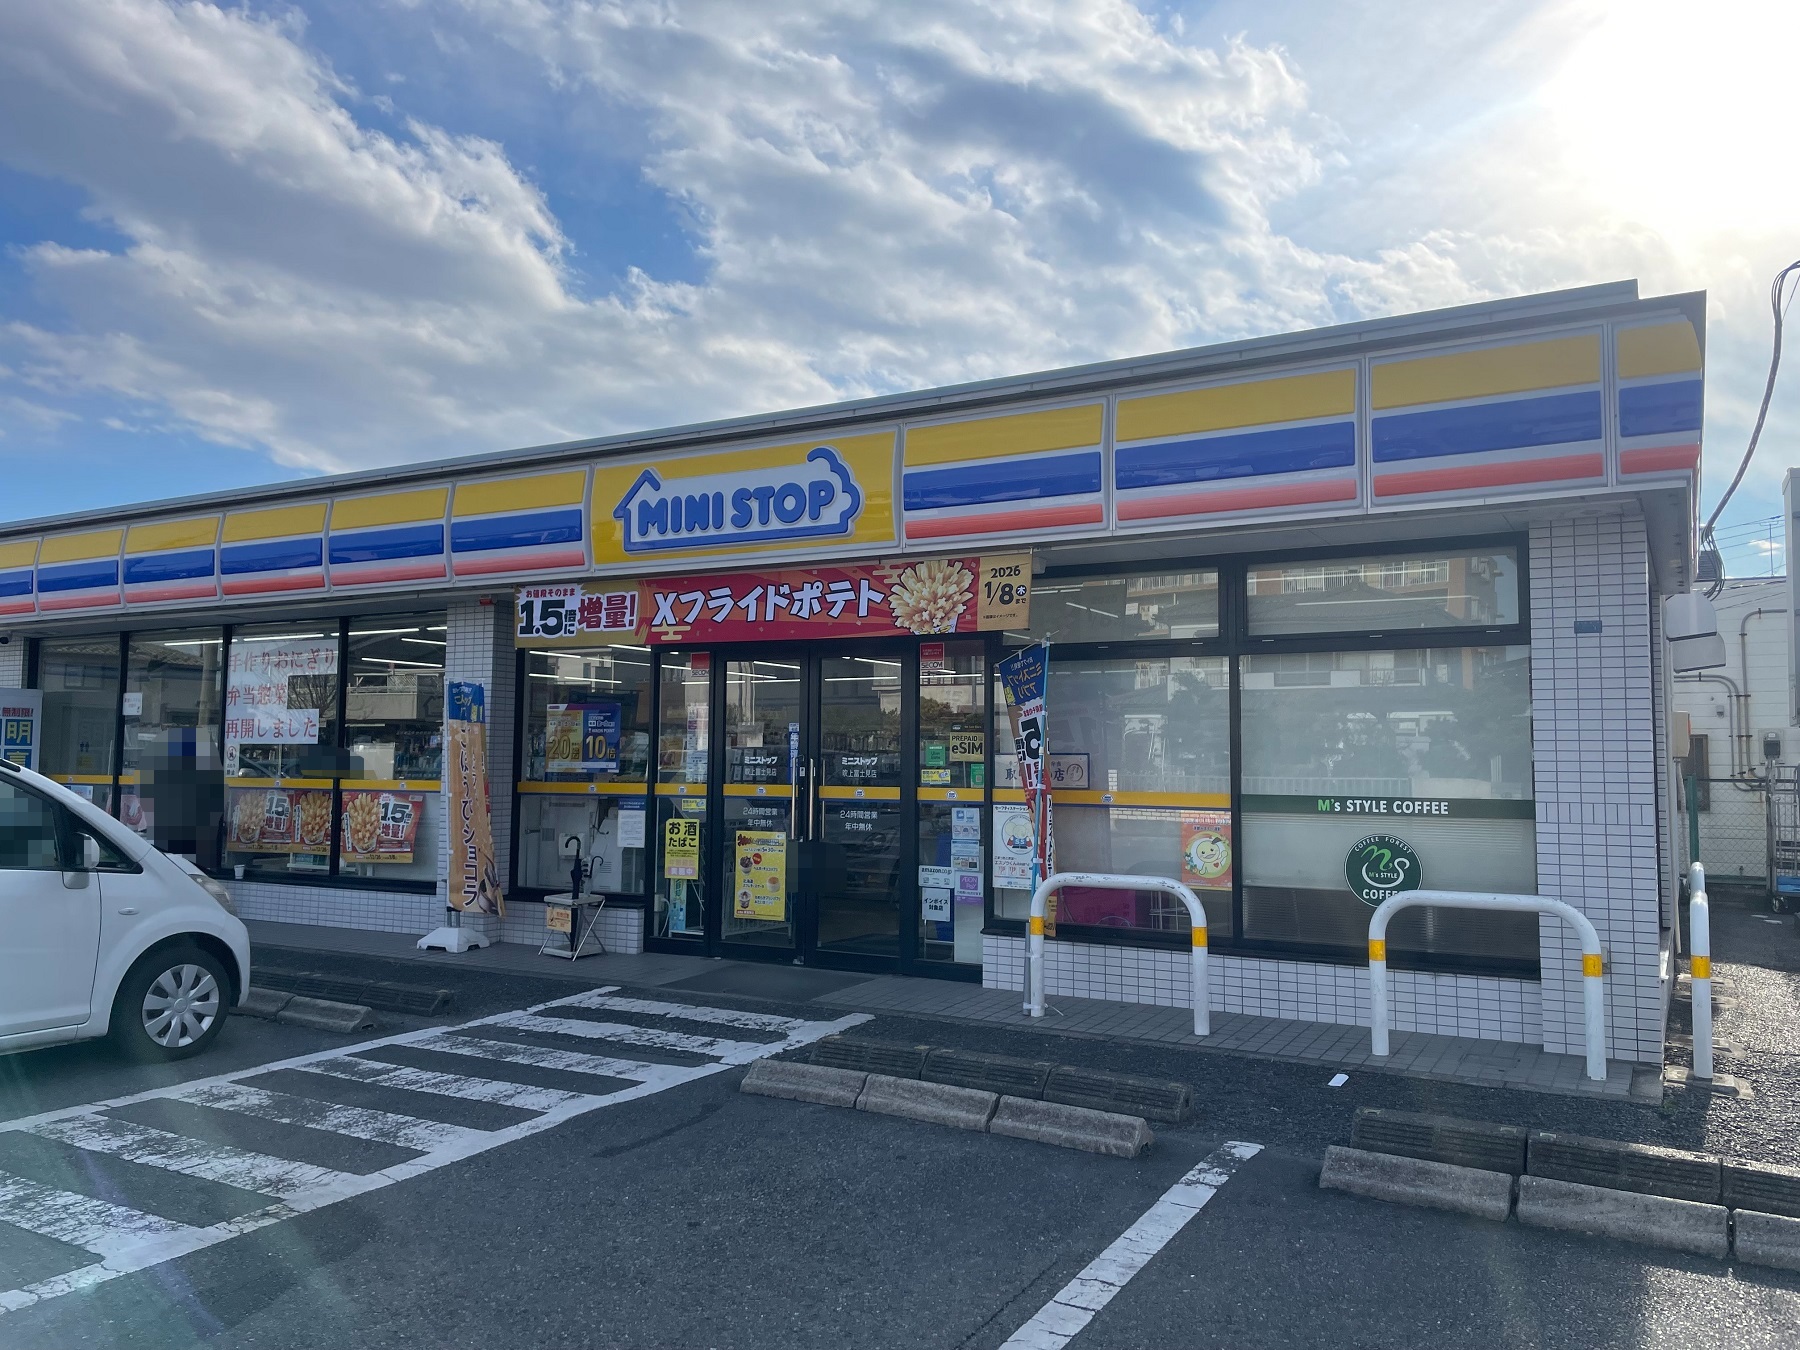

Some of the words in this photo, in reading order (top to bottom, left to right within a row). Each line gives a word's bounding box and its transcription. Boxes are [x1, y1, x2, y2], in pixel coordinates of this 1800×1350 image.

[637, 491, 724, 537] MINI
[731, 479, 835, 529] STOP
[991, 564, 1021, 578] 2026
[525, 587, 576, 598] お値段そのまま
[985, 582, 1014, 605] 1/8
[651, 578, 886, 626] Xフライドポテト
[229, 648, 335, 673] 手作りおにぎり
[921, 661, 943, 669] SECOM
[228, 683, 287, 707] 弁当惣菜
[226, 717, 317, 740] 再開しました
[586, 735, 606, 759] 10
[952, 742, 983, 755] eSIM
[842, 757, 878, 765] ミニストップ
[744, 768, 777, 777] 吹上富士見店
[842, 769, 877, 778] 吹上富士見店
[743, 806, 778, 815] 24時間営業
[1317, 799, 1341, 812] M's
[1346, 800, 1387, 813] STYLE
[1393, 801, 1449, 815] COFFEE
[840, 810, 878, 819] 24時間営業
[669, 822, 698, 837] お酒
[748, 819, 773, 827] 年中無休
[845, 822, 873, 831] 年中無休
[668, 837, 697, 848] たばこ
[1355, 837, 1379, 852] COFFEE
[1385, 837, 1411, 854] FOREST
[921, 867, 953, 876] amazon.co.jp
